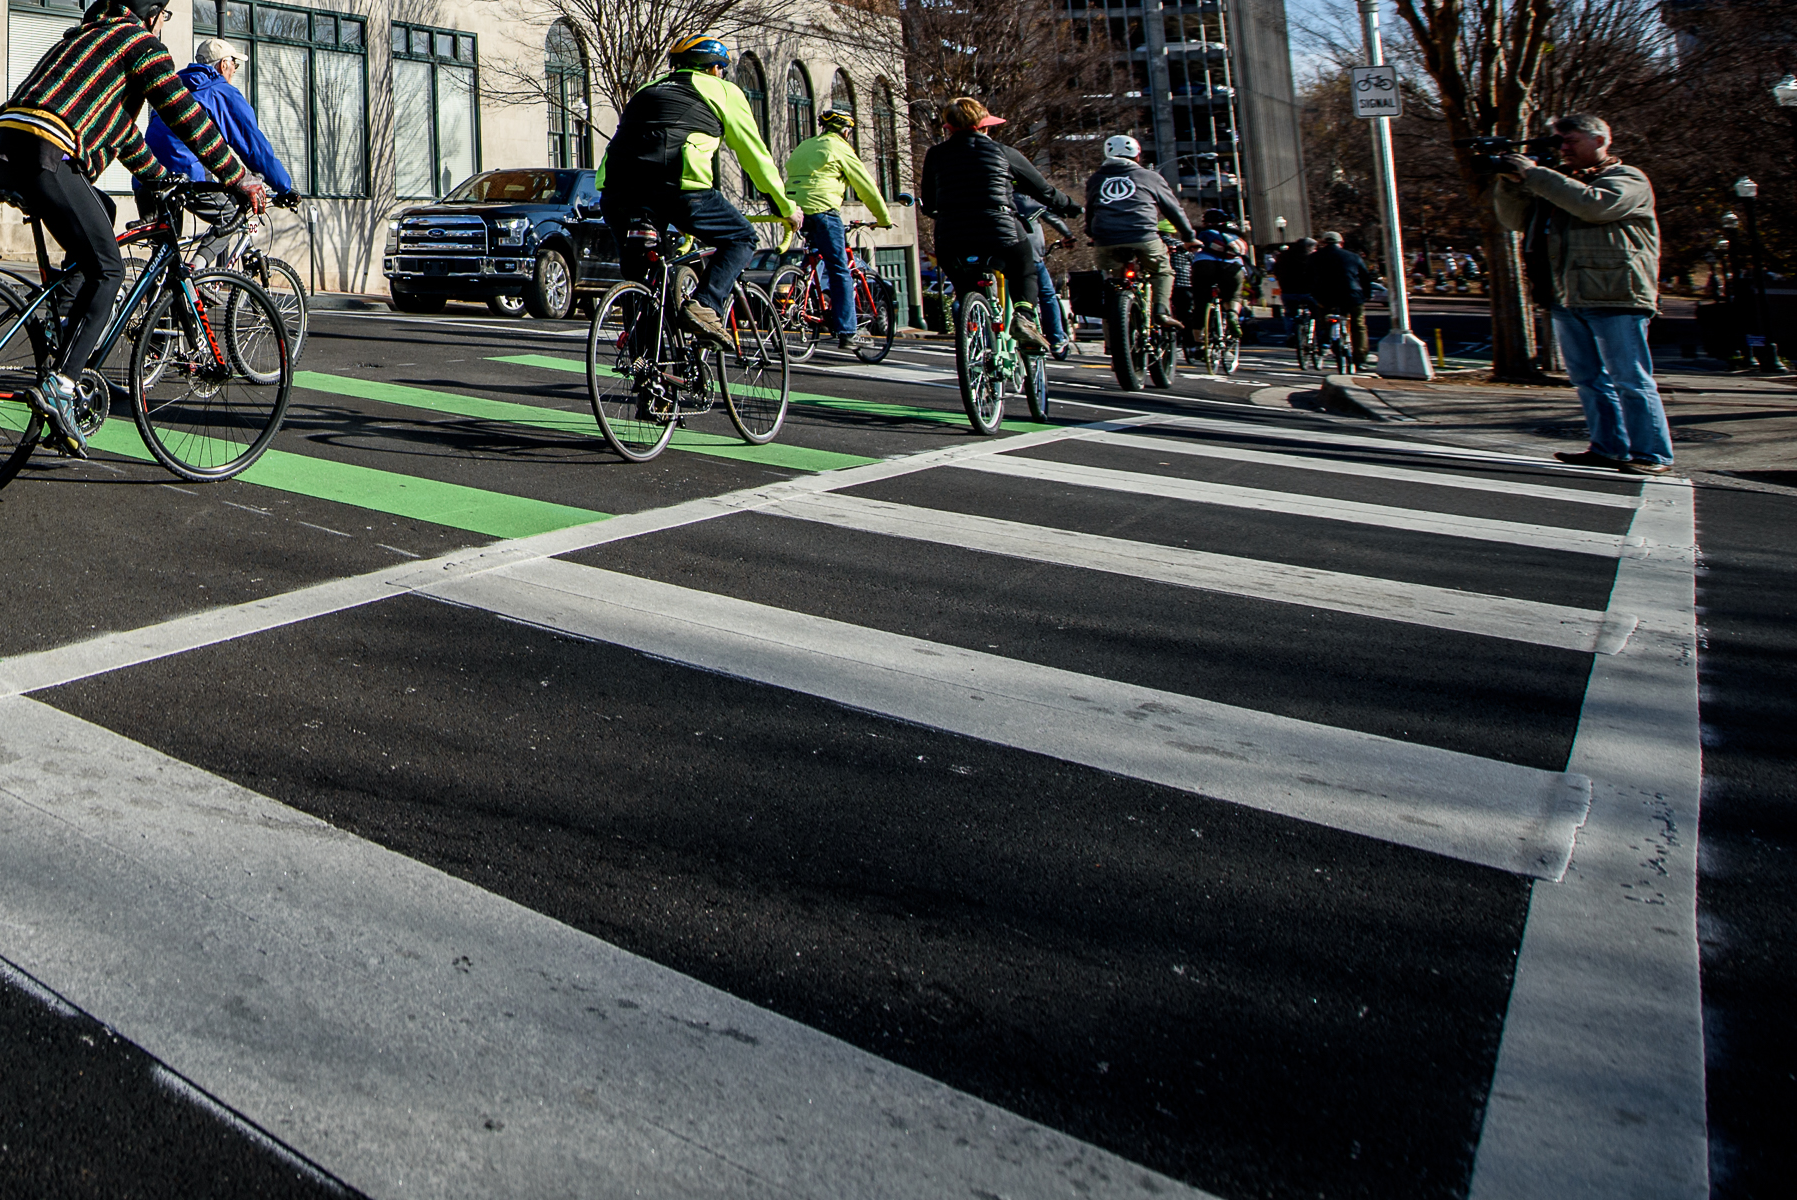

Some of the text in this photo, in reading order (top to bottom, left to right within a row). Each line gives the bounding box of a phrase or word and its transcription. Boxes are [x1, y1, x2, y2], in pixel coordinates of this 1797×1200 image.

[1359, 98, 1396, 108] SIGNAL
[148, 243, 168, 274] GIANT
[193, 286, 226, 366] NYROAD
